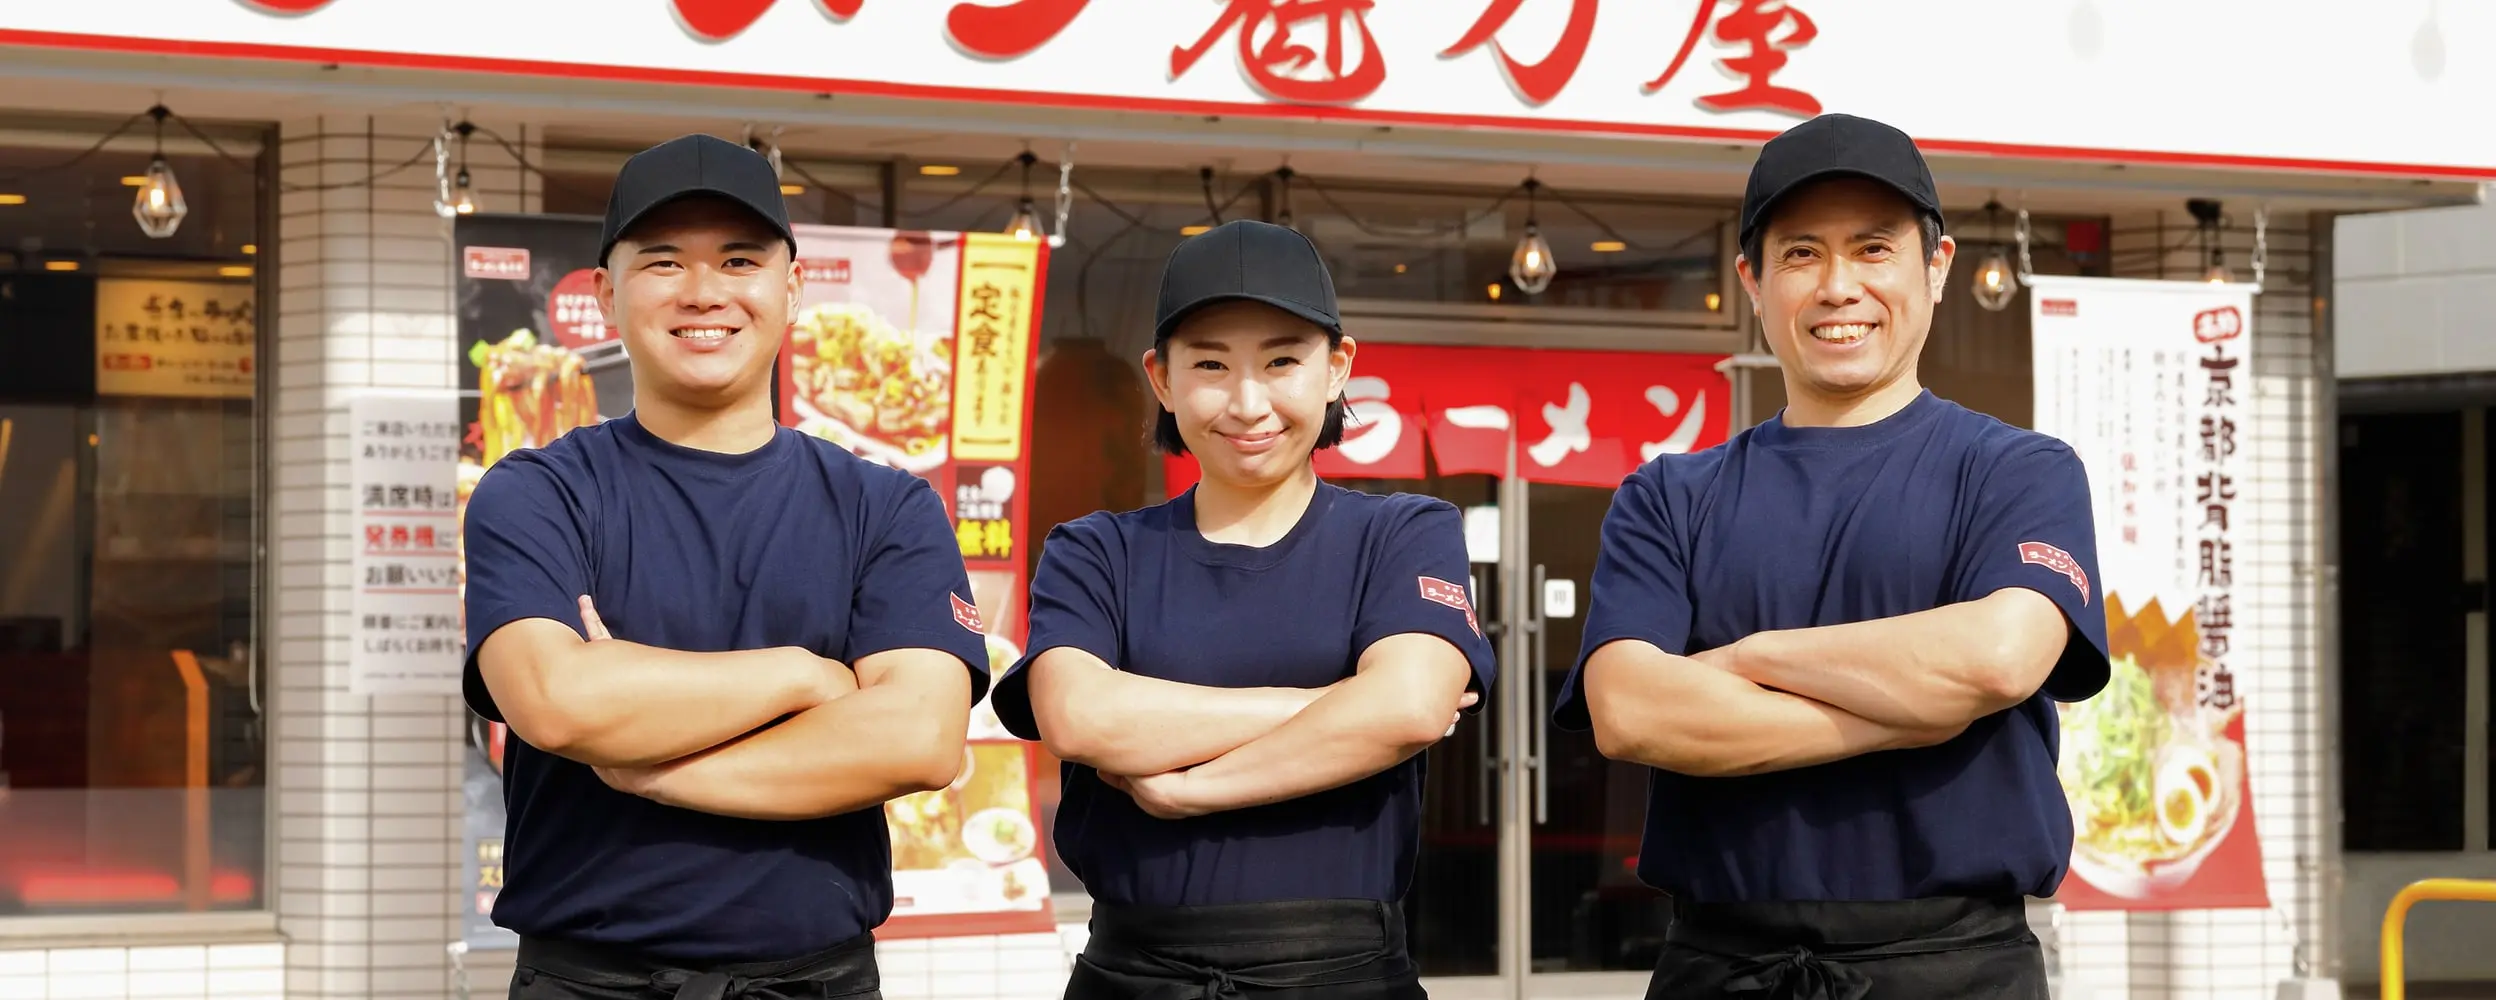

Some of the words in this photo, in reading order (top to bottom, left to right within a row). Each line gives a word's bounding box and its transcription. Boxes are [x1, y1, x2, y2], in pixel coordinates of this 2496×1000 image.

[1338, 376, 1706, 465] ラーメン
[363, 485, 458, 508] 満席時は
[2197, 344, 2238, 709] 京都背脂醤油
